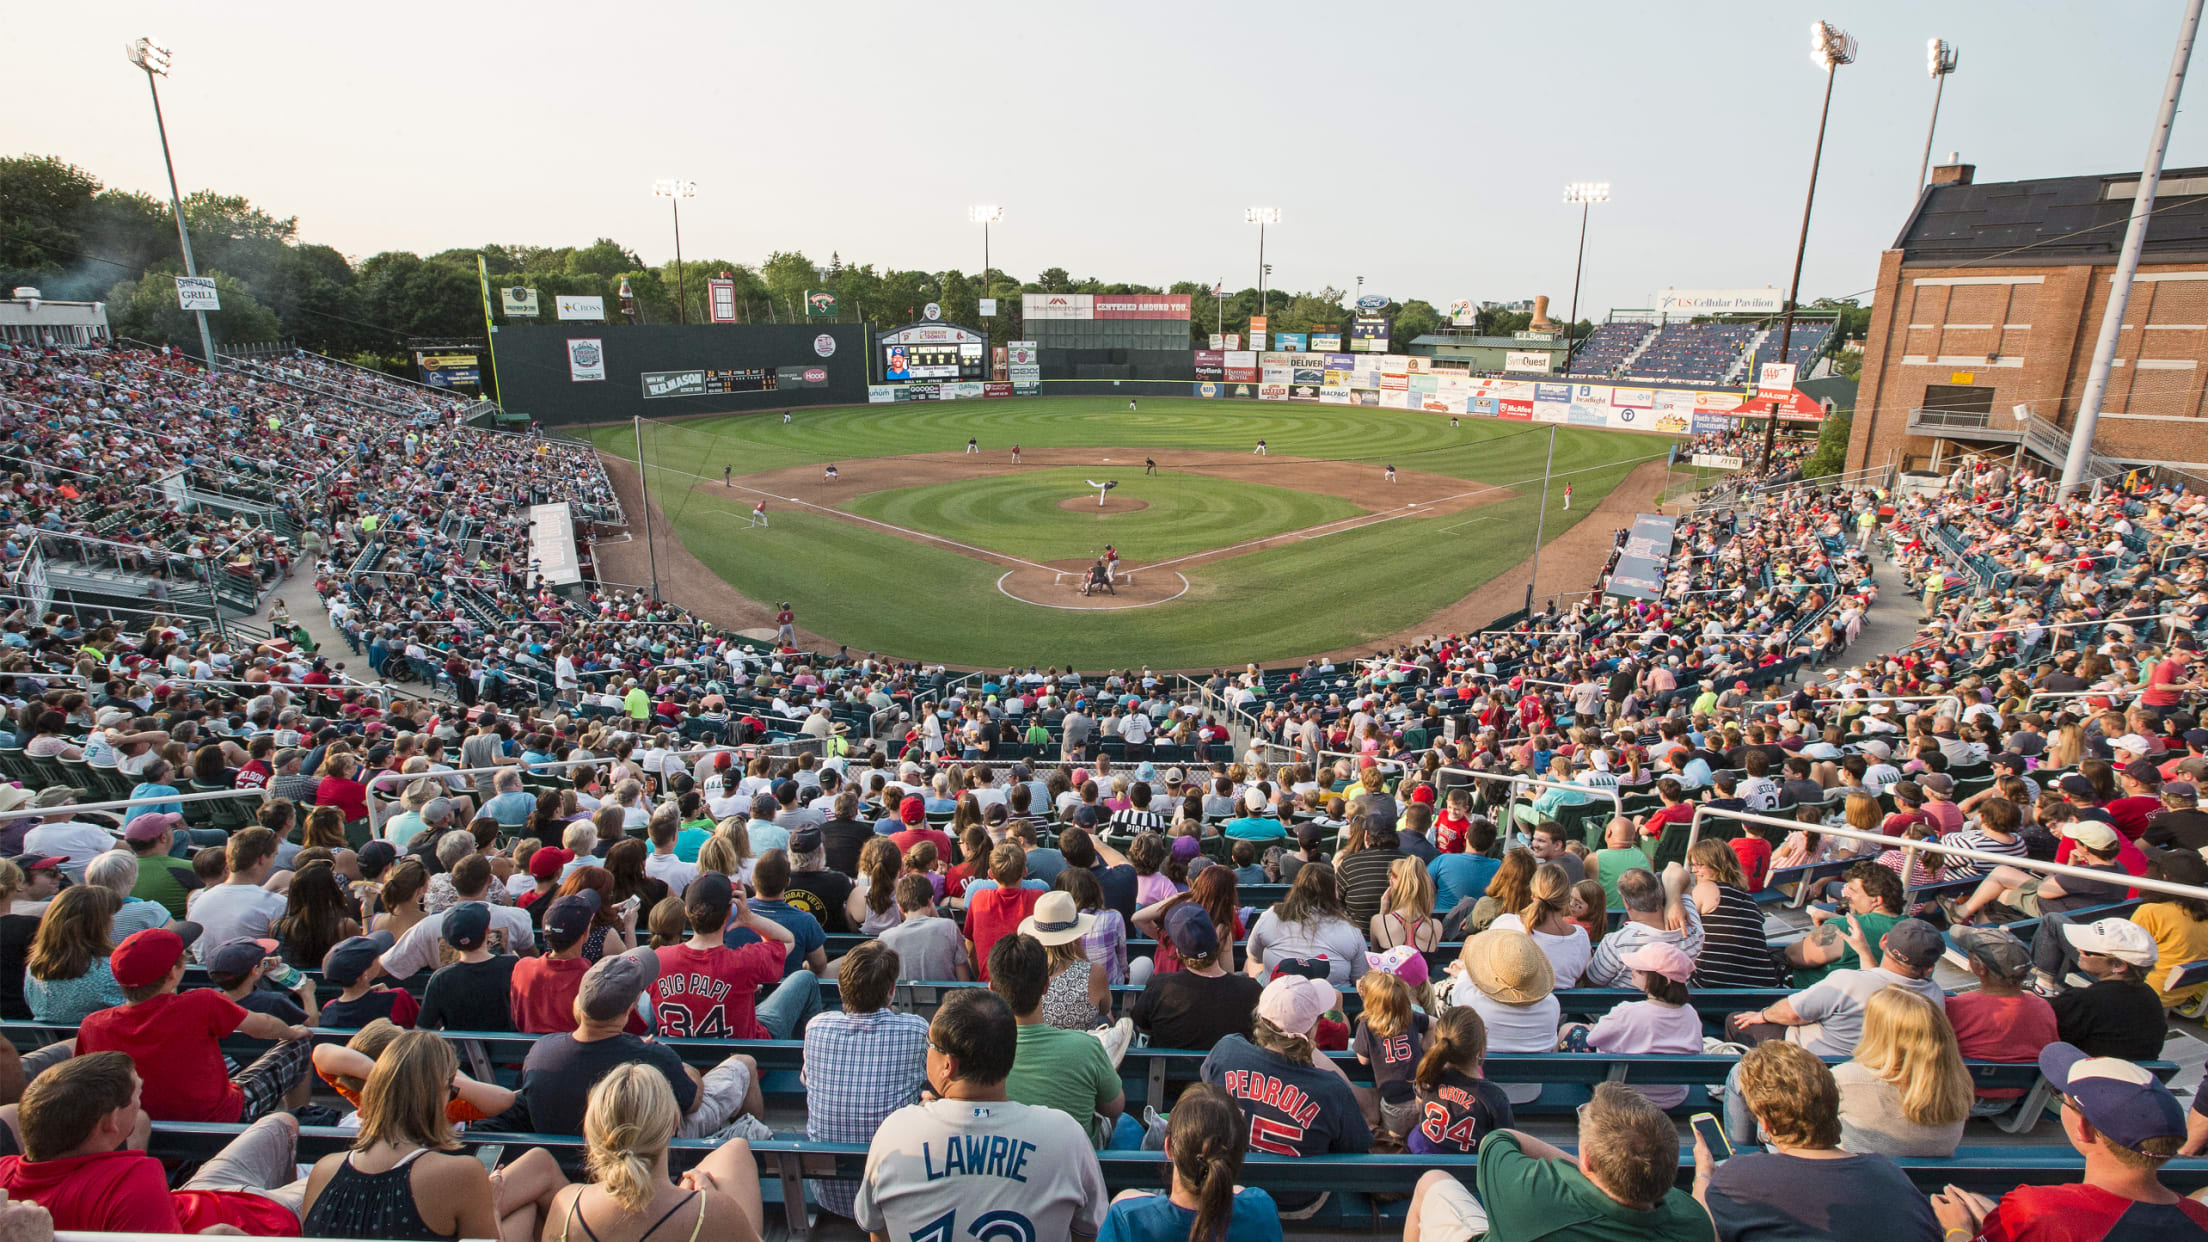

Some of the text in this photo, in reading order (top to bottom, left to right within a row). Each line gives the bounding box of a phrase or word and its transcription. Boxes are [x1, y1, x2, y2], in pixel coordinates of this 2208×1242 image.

[182, 291, 215, 299] GRILL
[1693, 297, 1732, 307] Cellular
[1735, 297, 1774, 307] Pavilion
[1096, 303, 1137, 311] CENTERED
[1138, 303, 1169, 311] AROUND
[1291, 359, 1324, 368] DELIVER
[1508, 356, 1547, 367] SymQuest
[1196, 367, 1223, 375] KeyBank
[1321, 390, 1349, 398] MACPAGE
[1760, 392, 1789, 401] AAA.com
[1757, 784, 1775, 795] JETER
[1765, 796, 1777, 810] 2
[1752, 856, 1763, 877] 1
[807, 894, 823, 911] VETS
[658, 973, 732, 1002] BIG PAPI
[658, 1002, 734, 1038] 34
[1383, 1035, 1412, 1063] 15
[1225, 1069, 1321, 1130] PEDROIA
[1439, 1084, 1476, 1111] ORTIZ
[1422, 1101, 1476, 1152] 34
[923, 1135, 1037, 1183] LAWRIE
